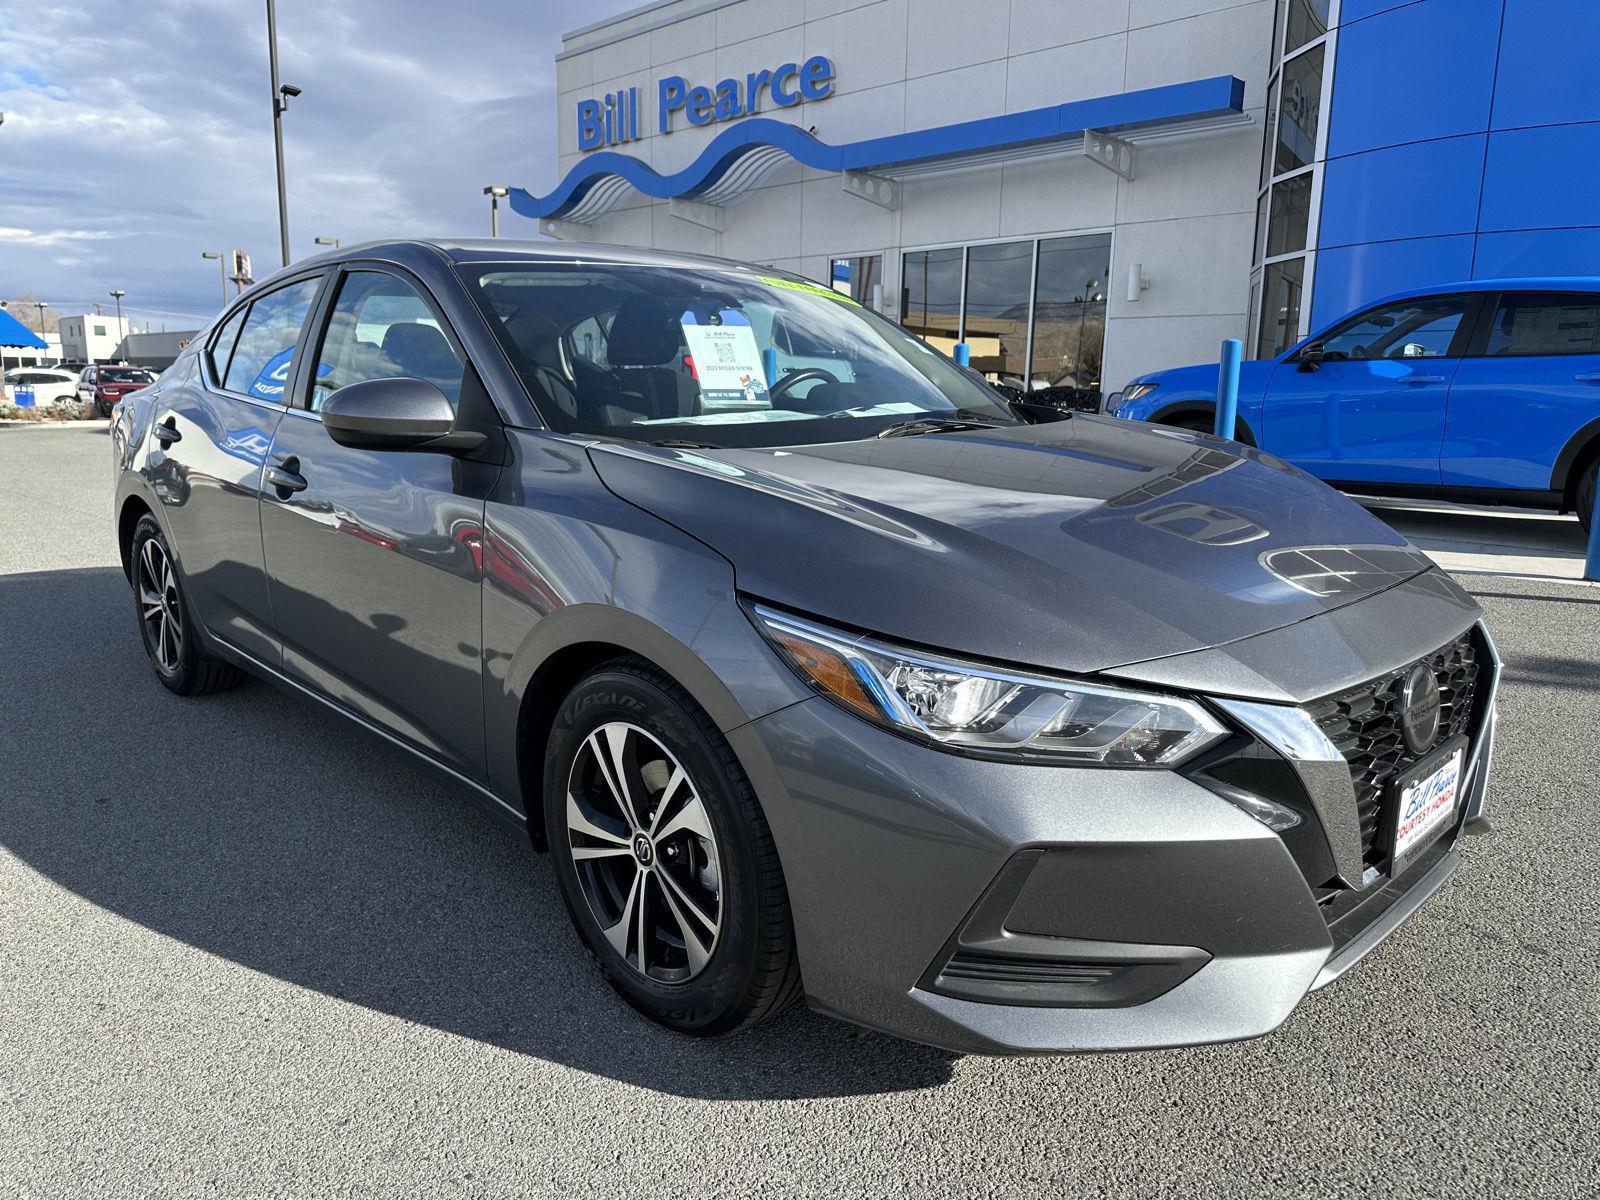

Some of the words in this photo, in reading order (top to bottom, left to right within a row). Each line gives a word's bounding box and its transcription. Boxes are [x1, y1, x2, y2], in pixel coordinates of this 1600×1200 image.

[577, 86, 640, 151] Bill
[658, 55, 834, 133] Pearce
[1396, 807, 1431, 841] COURTESY
[1431, 787, 1454, 811] HONDA
[1404, 780, 1432, 821] Bill
